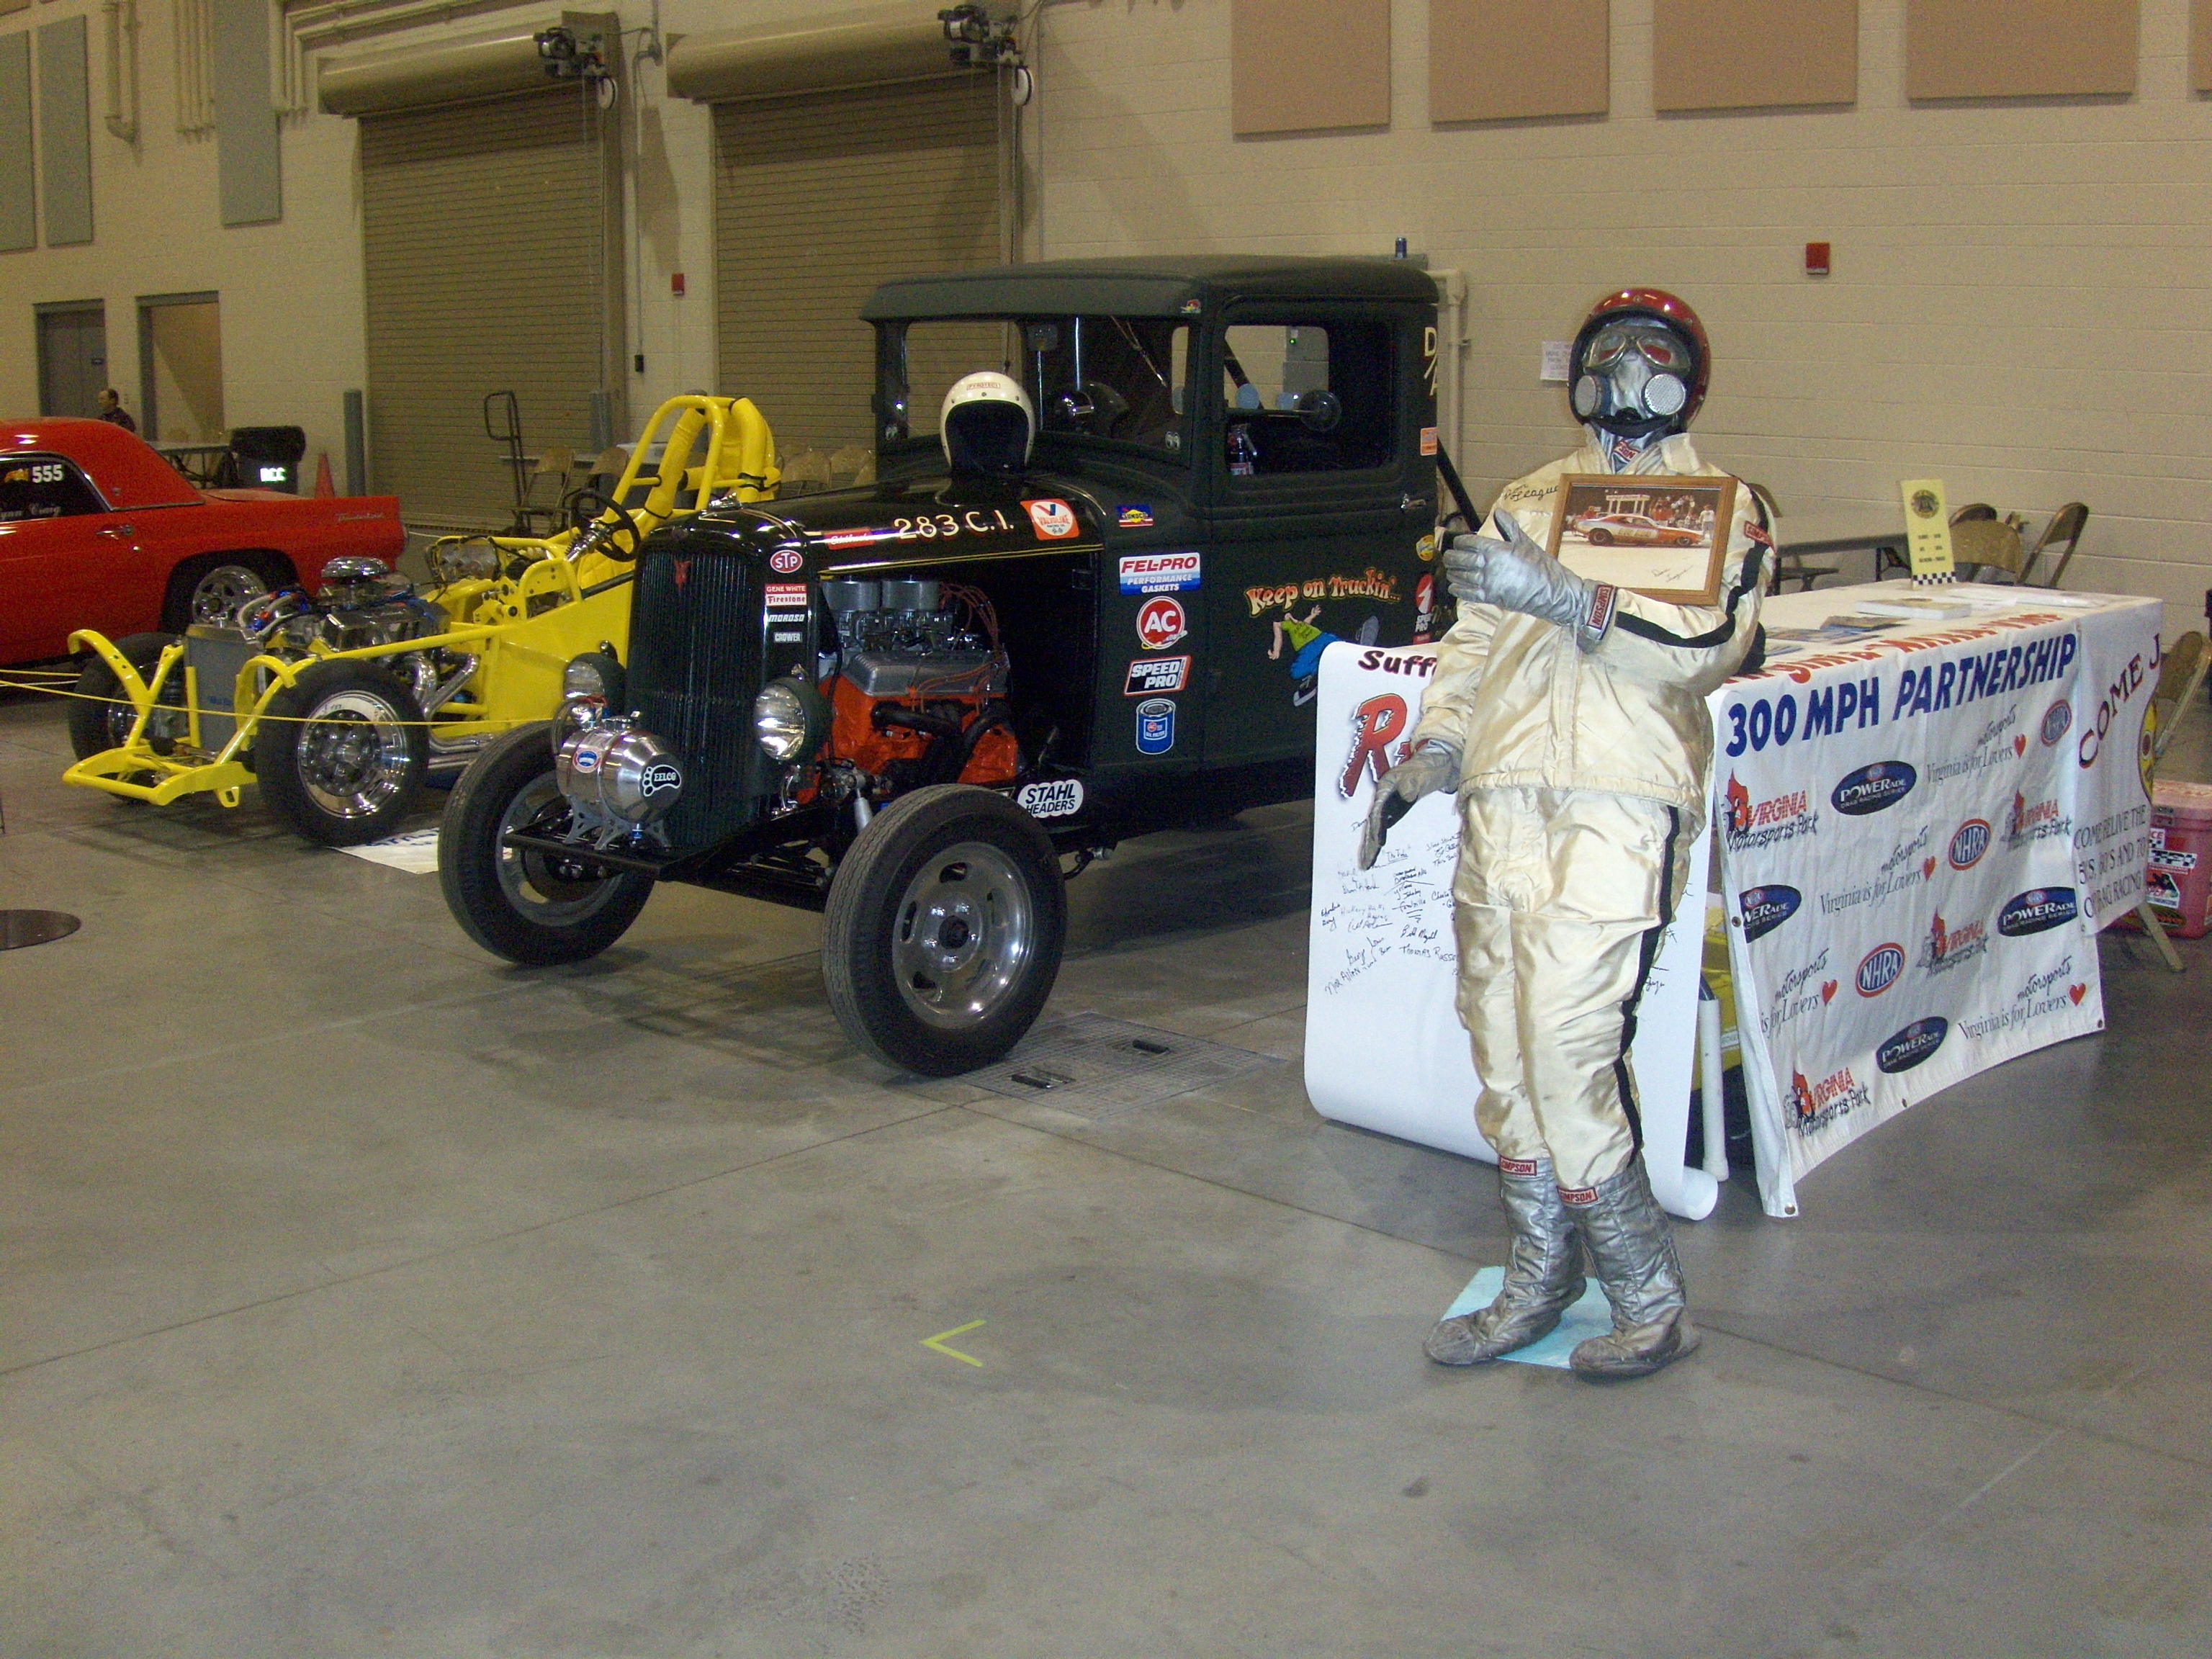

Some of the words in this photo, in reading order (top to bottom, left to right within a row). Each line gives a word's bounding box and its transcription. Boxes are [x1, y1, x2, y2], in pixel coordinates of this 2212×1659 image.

[32, 464, 63, 483] 555
[894, 514, 959, 539] 283
[775, 552, 798, 569] STP
[1121, 557, 1197, 573] FEL-PRO
[1127, 574, 1192, 585] PERFORMANCE
[1141, 583, 1179, 593] GASKETS
[1245, 584, 1298, 616] Keep
[1303, 579, 1326, 599] on
[1591, 587, 1609, 626] SIMPSON
[1144, 611, 1176, 633] AC
[1131, 661, 1180, 678] SPEED
[1358, 650, 1437, 678] Suff
[1144, 674, 1177, 688] PRO
[1725, 694, 1797, 757] 300
[1802, 676, 1879, 741] MPH
[1892, 633, 2077, 720] PARTNERSHIP
[2079, 653, 2144, 769] COME
[654, 773, 676, 781] EELCO
[1025, 783, 1075, 804] STAHL
[1026, 799, 1075, 814] HEADERS
[1748, 790, 1807, 828] VIRGINIA
[1796, 809, 1819, 836] Park
[1953, 827, 1989, 863] NHRA
[1820, 886, 1861, 917] Virginia
[1885, 869, 1922, 895] Lovers
[1775, 948, 1830, 1002] motorsports
[1861, 950, 1901, 990] NHRA
[2017, 955, 2072, 1002] motorsports
[1781, 993, 1820, 1022] Lovers
[1958, 1012, 2000, 1040] Virginia
[2025, 994, 2067, 1020] Lovers
[1848, 1082, 1871, 1106] Park
